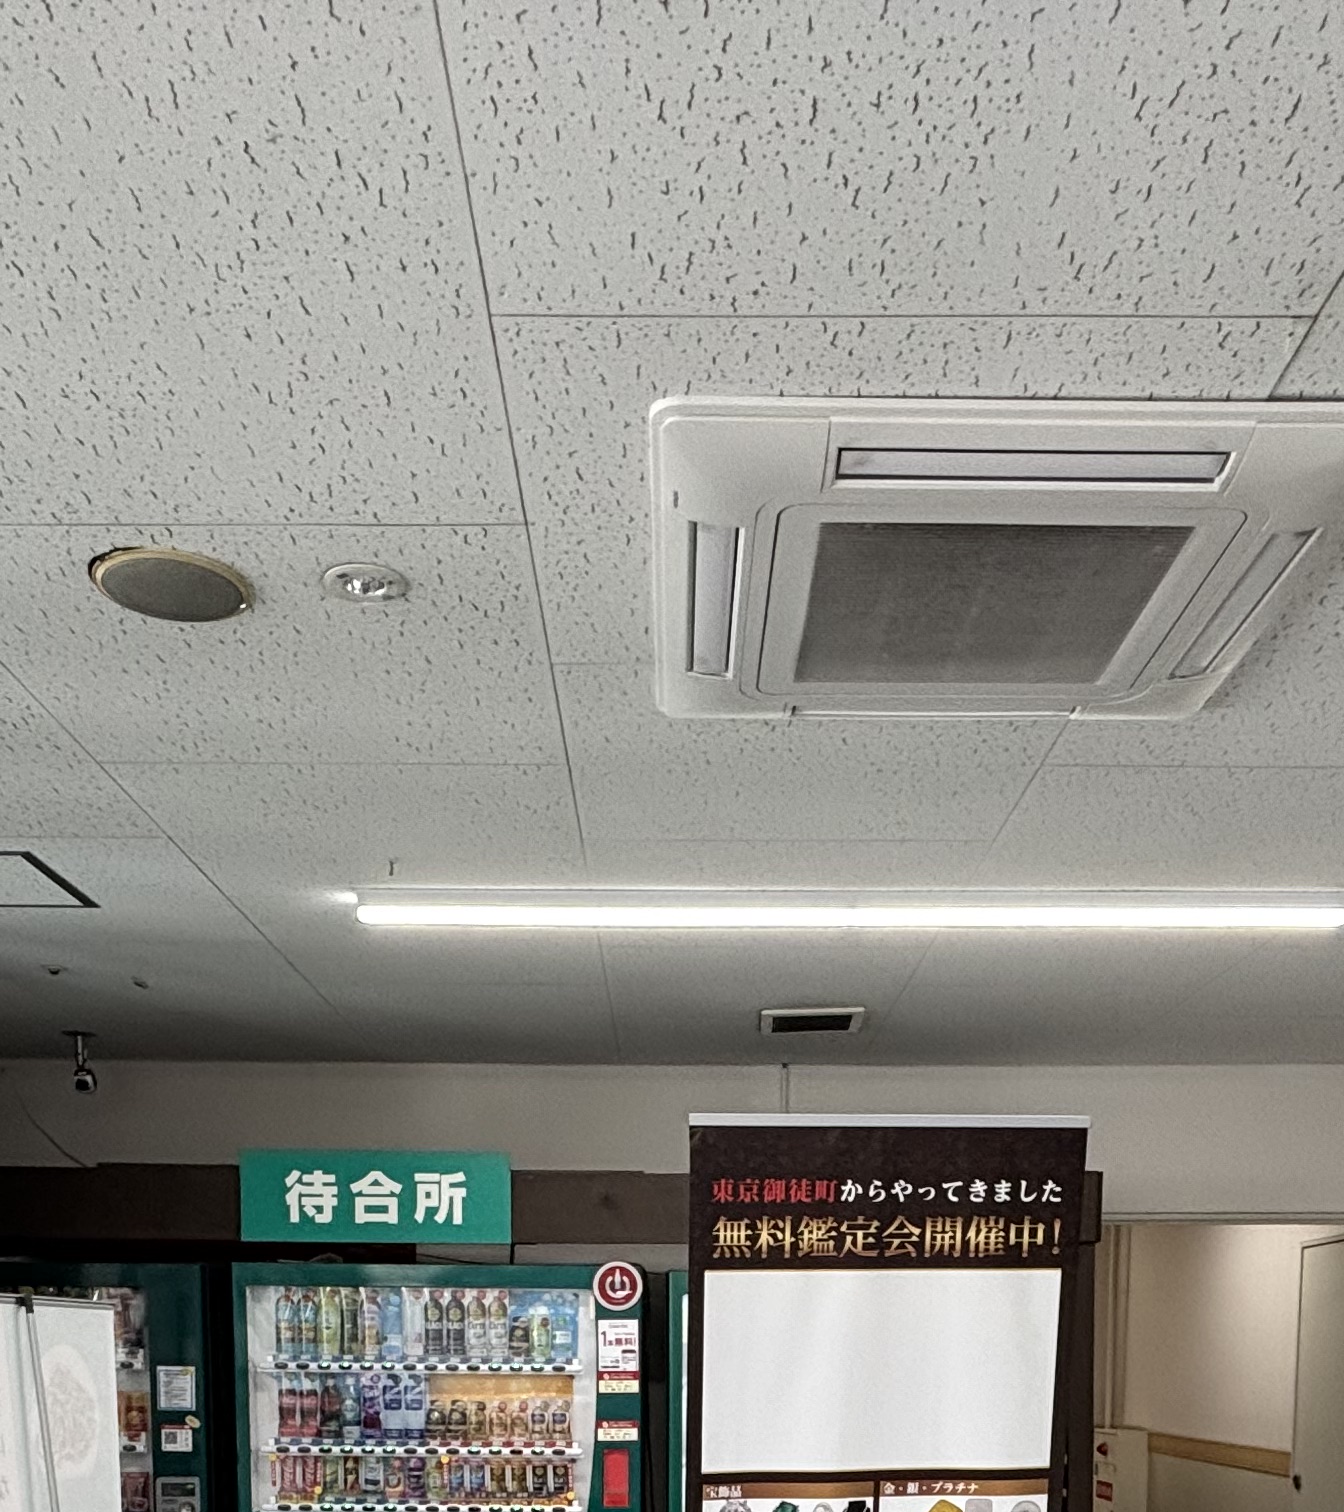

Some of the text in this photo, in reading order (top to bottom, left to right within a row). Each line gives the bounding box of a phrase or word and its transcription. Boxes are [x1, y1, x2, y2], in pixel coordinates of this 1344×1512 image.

[284, 1170, 467, 1225] 待合所
[712, 1177, 1062, 1203] 東京御徒町からやってきました
[884, 1481, 978, 1495] 金・銀・プラチナ
